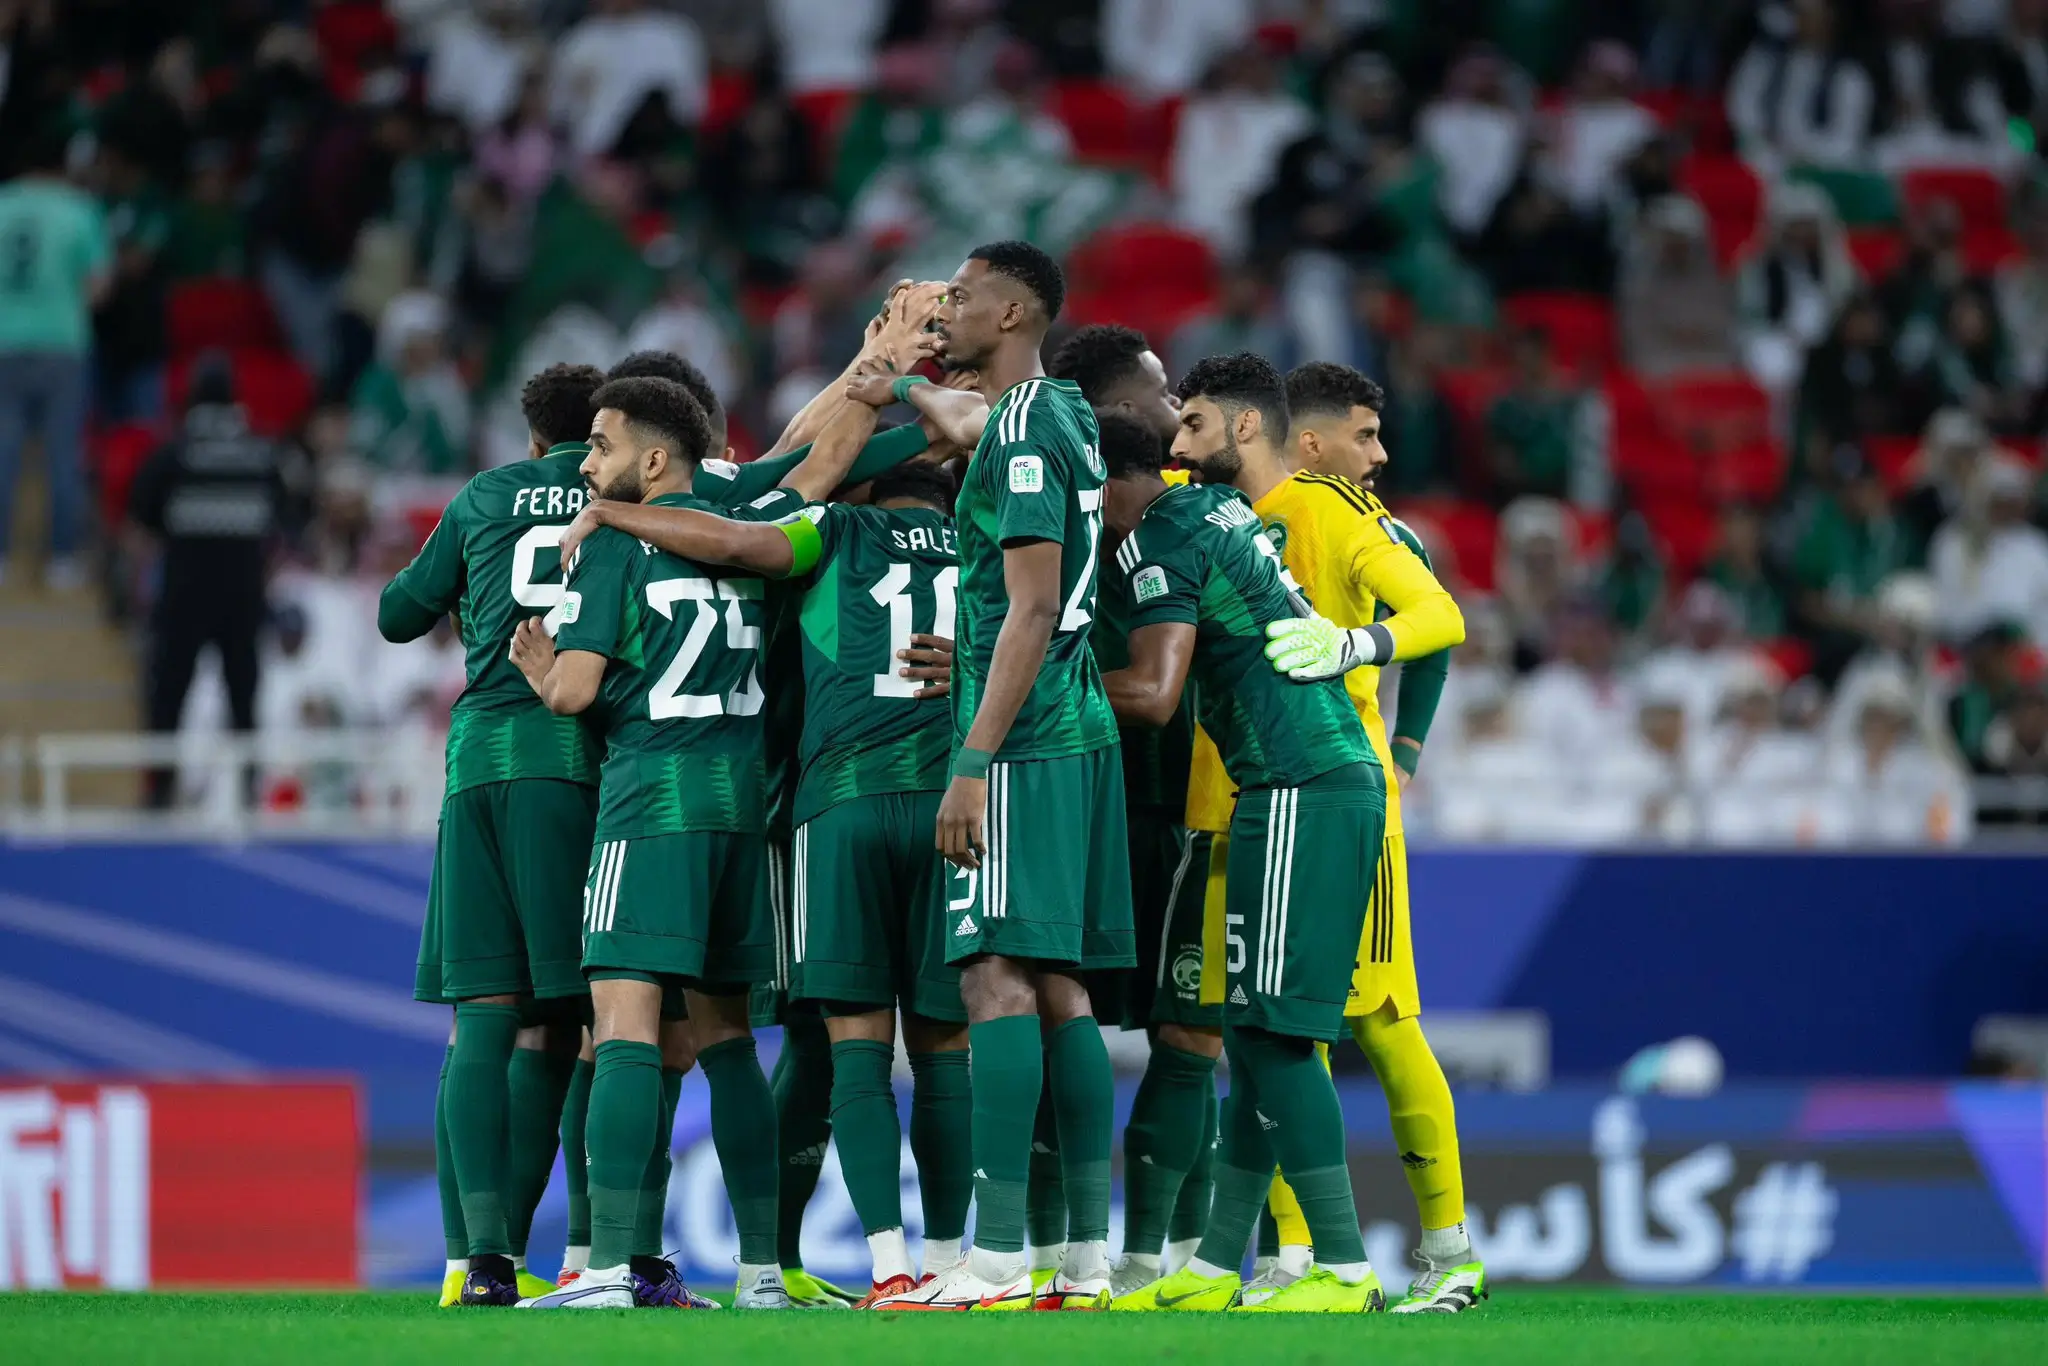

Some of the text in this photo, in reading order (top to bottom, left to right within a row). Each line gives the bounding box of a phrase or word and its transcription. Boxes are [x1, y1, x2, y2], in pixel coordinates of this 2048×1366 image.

[1013, 468, 1038, 478] LIVE
[891, 527, 959, 556] SALE
[1137, 573, 1149, 583] AFC
[1138, 576, 1161, 591] LIVE
[646, 577, 765, 720] 25
[955, 926, 978, 936] adidas
[1229, 996, 1249, 1006] adidas
